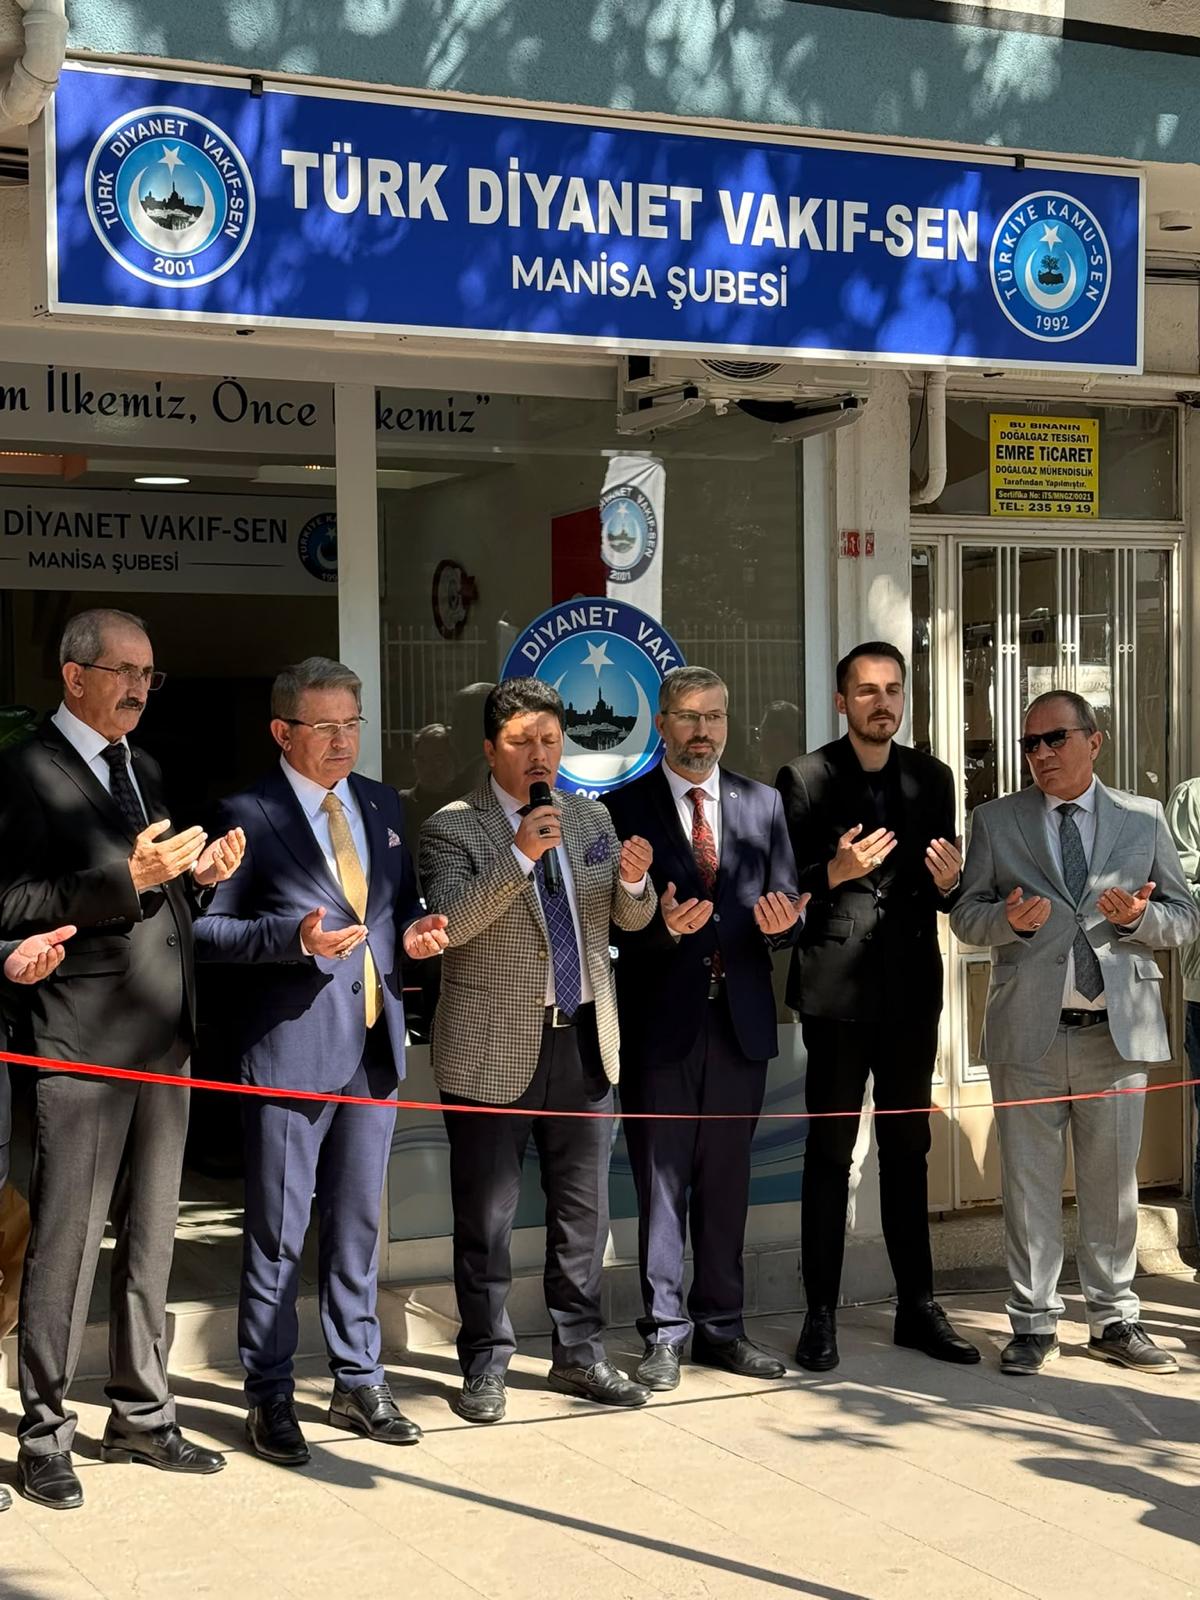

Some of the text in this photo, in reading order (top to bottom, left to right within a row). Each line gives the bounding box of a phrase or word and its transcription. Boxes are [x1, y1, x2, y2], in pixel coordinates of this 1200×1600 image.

[97, 118, 245, 239] TÜRK DİYANET VAKIF-SEN
[281, 141, 978, 262] TÜRK DİYANET VAKIF-SEN
[153, 257, 195, 275] 2001
[1047, 200, 1103, 301] KAMU-SEN
[512, 252, 787, 310] MANİSA ŞUBESİ
[1036, 315, 1070, 331] 1992
[212, 376, 317, 426] Önce
[1009, 421, 1026, 429] BU
[996, 444, 1034, 461] EMRE
[4, 504, 287, 543] DİYANET VAKIF-SEN
[999, 502, 1091, 513] TEL: 235 19 19
[28, 548, 179, 574] MANİSA ŞUBESİ
[521, 606, 619, 662] DİYANET
